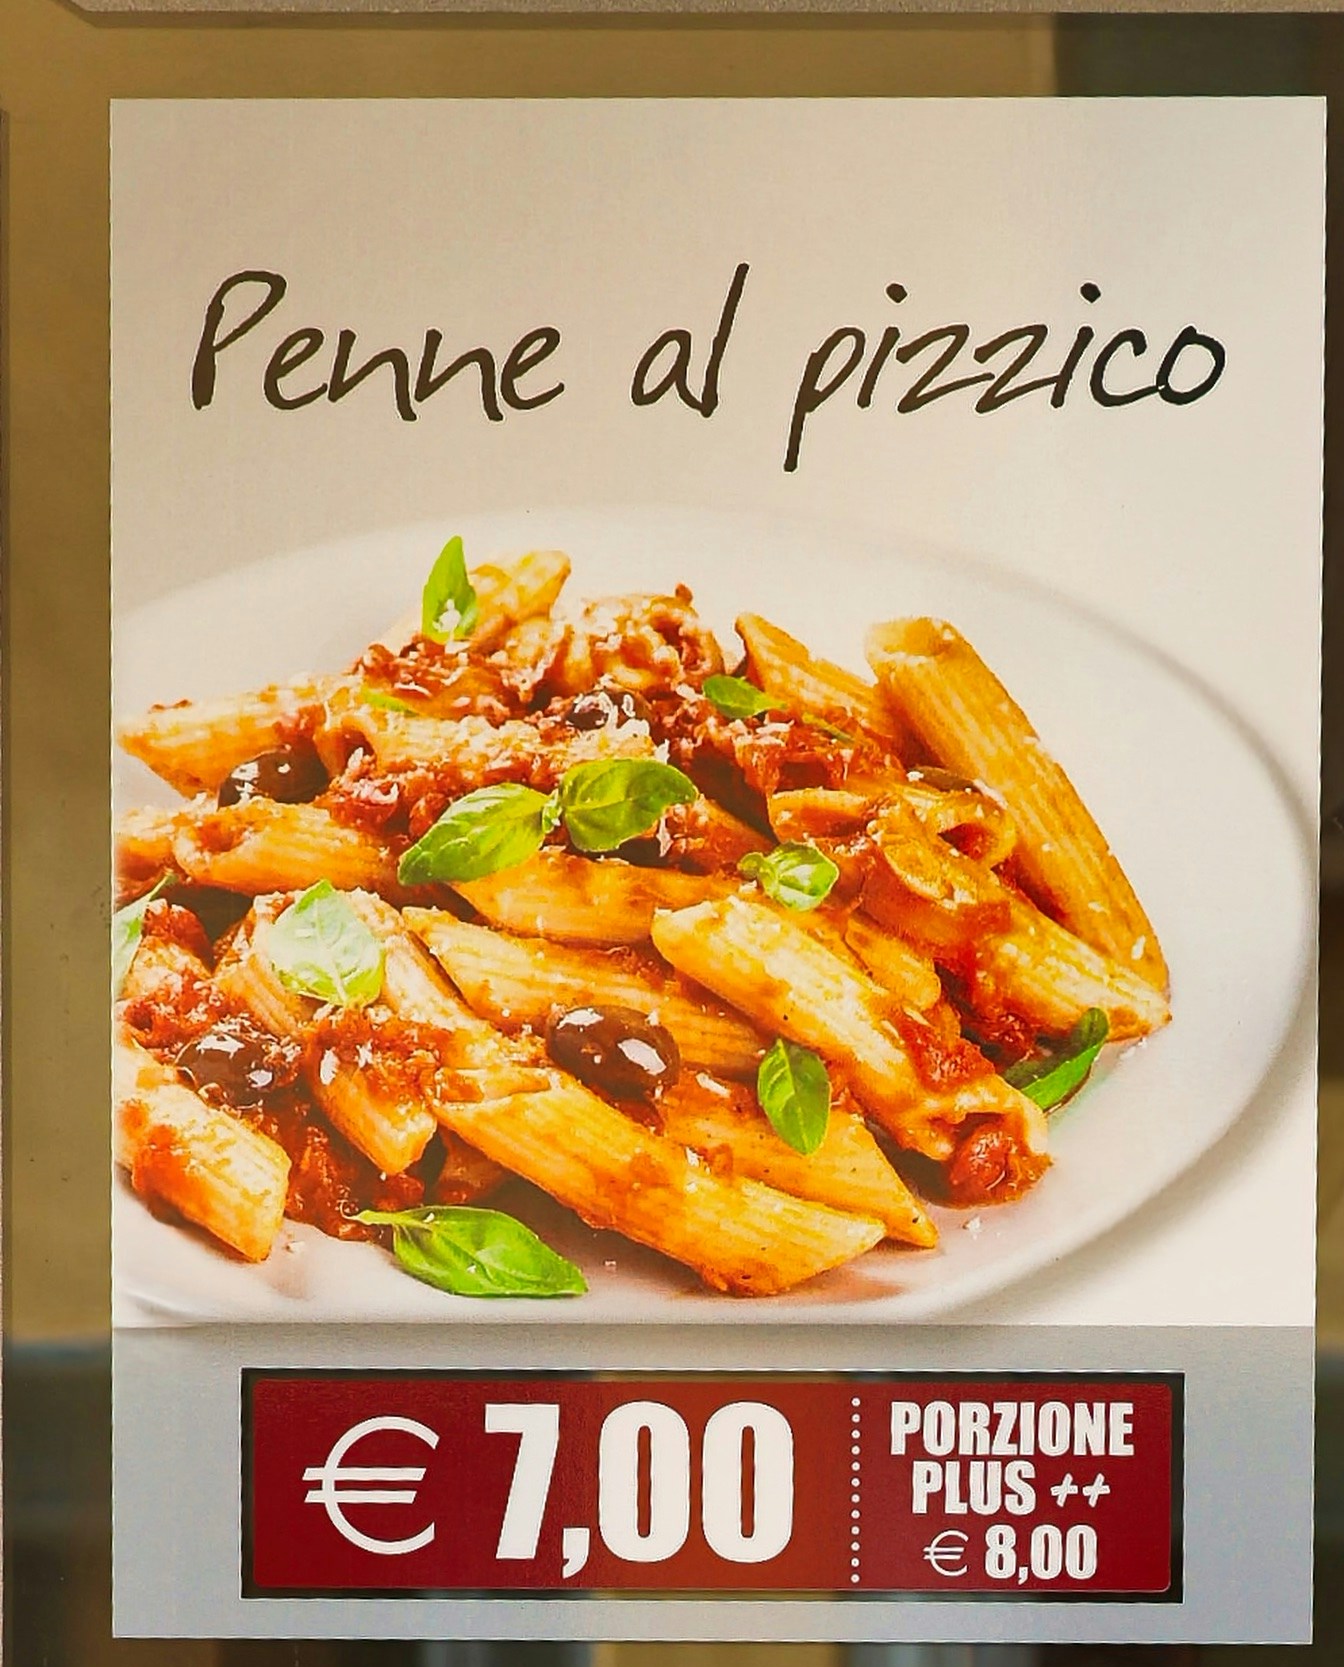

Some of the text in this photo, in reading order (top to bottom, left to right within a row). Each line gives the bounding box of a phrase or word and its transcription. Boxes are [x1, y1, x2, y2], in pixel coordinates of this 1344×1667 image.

[192, 264, 1225, 472] Penne al pizzico
[891, 1401, 1134, 1456] PORZIONE
[303, 1401, 793, 1578] € 7,00
[913, 1461, 1110, 1515] PLUS ++
[924, 1525, 1097, 1584] € 8,00
